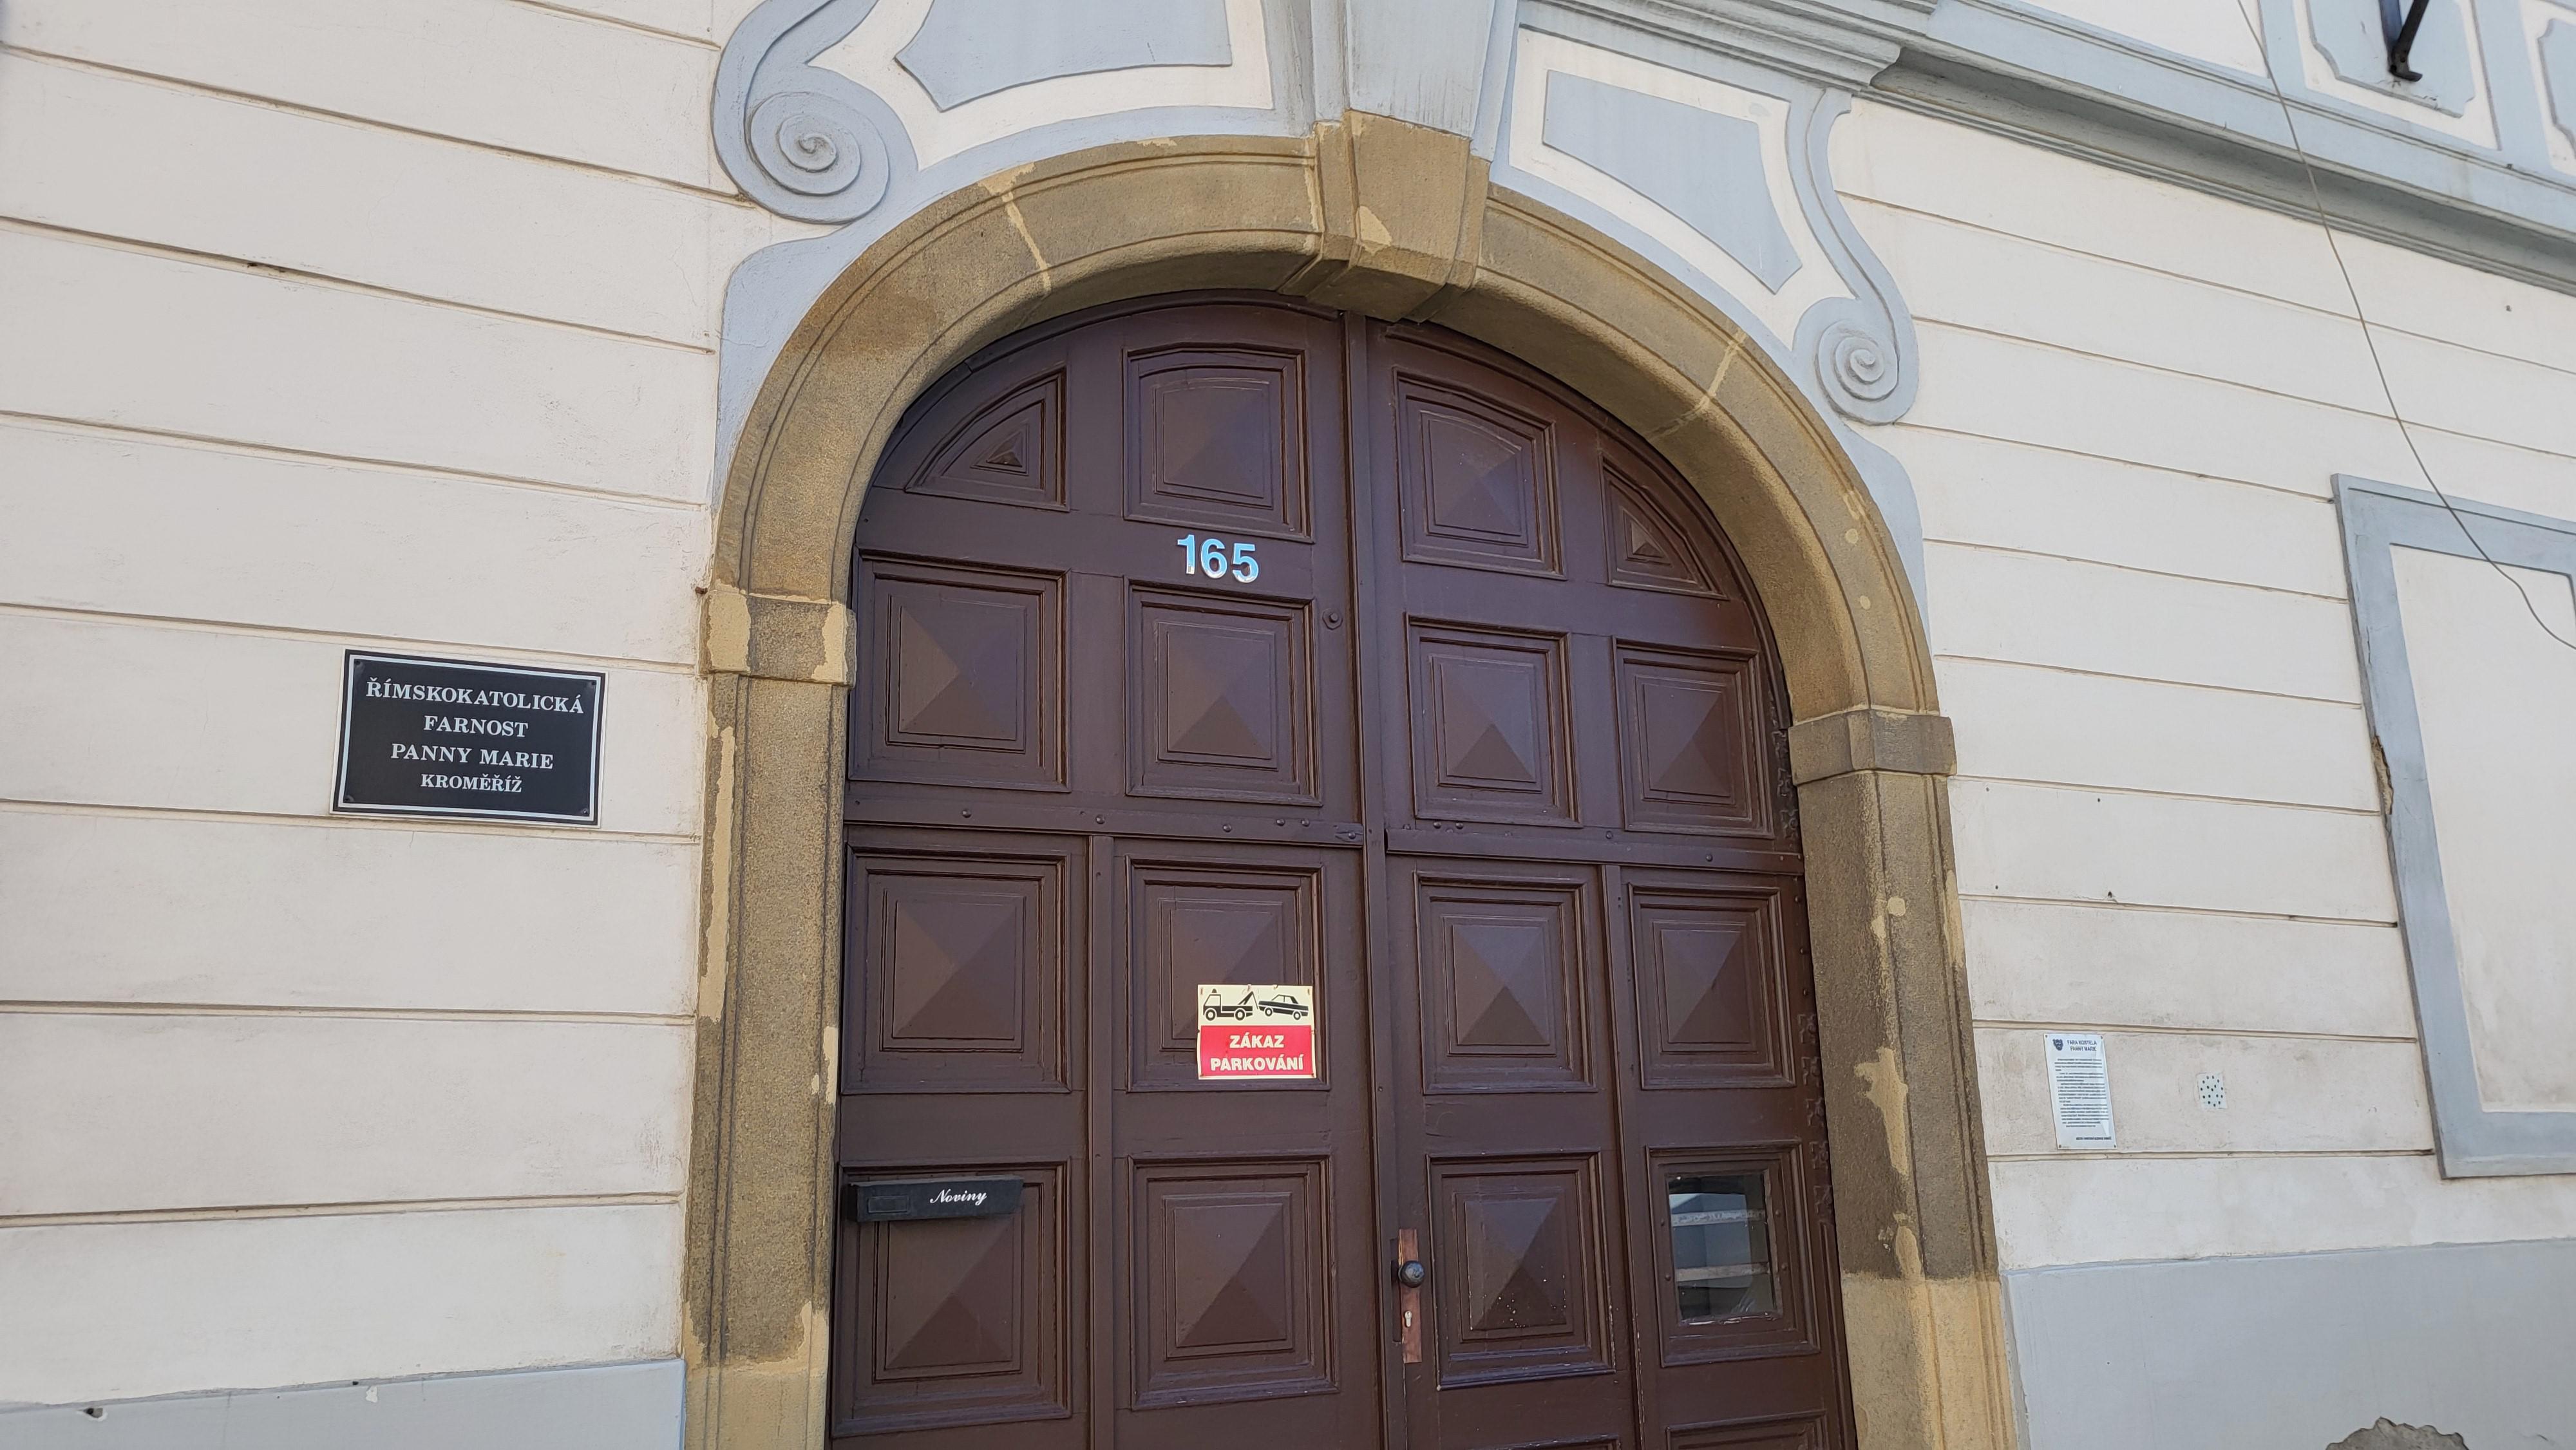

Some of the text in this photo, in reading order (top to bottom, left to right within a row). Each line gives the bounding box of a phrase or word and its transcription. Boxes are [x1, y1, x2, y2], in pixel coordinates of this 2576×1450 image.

[1177, 534, 1259, 583] 165
[365, 677, 584, 714] ŘÍMSKOKATOLICKÁ
[422, 715, 529, 737] FARNOST
[390, 743, 554, 769] PANNY MARIE
[420, 773, 523, 793] KROMĚŘÍŽ
[1229, 1032, 1284, 1049] ZÁKAZ
[1210, 1054, 1304, 1071] PARKOVÁNÍ
[929, 1189, 987, 1206] Noviny
